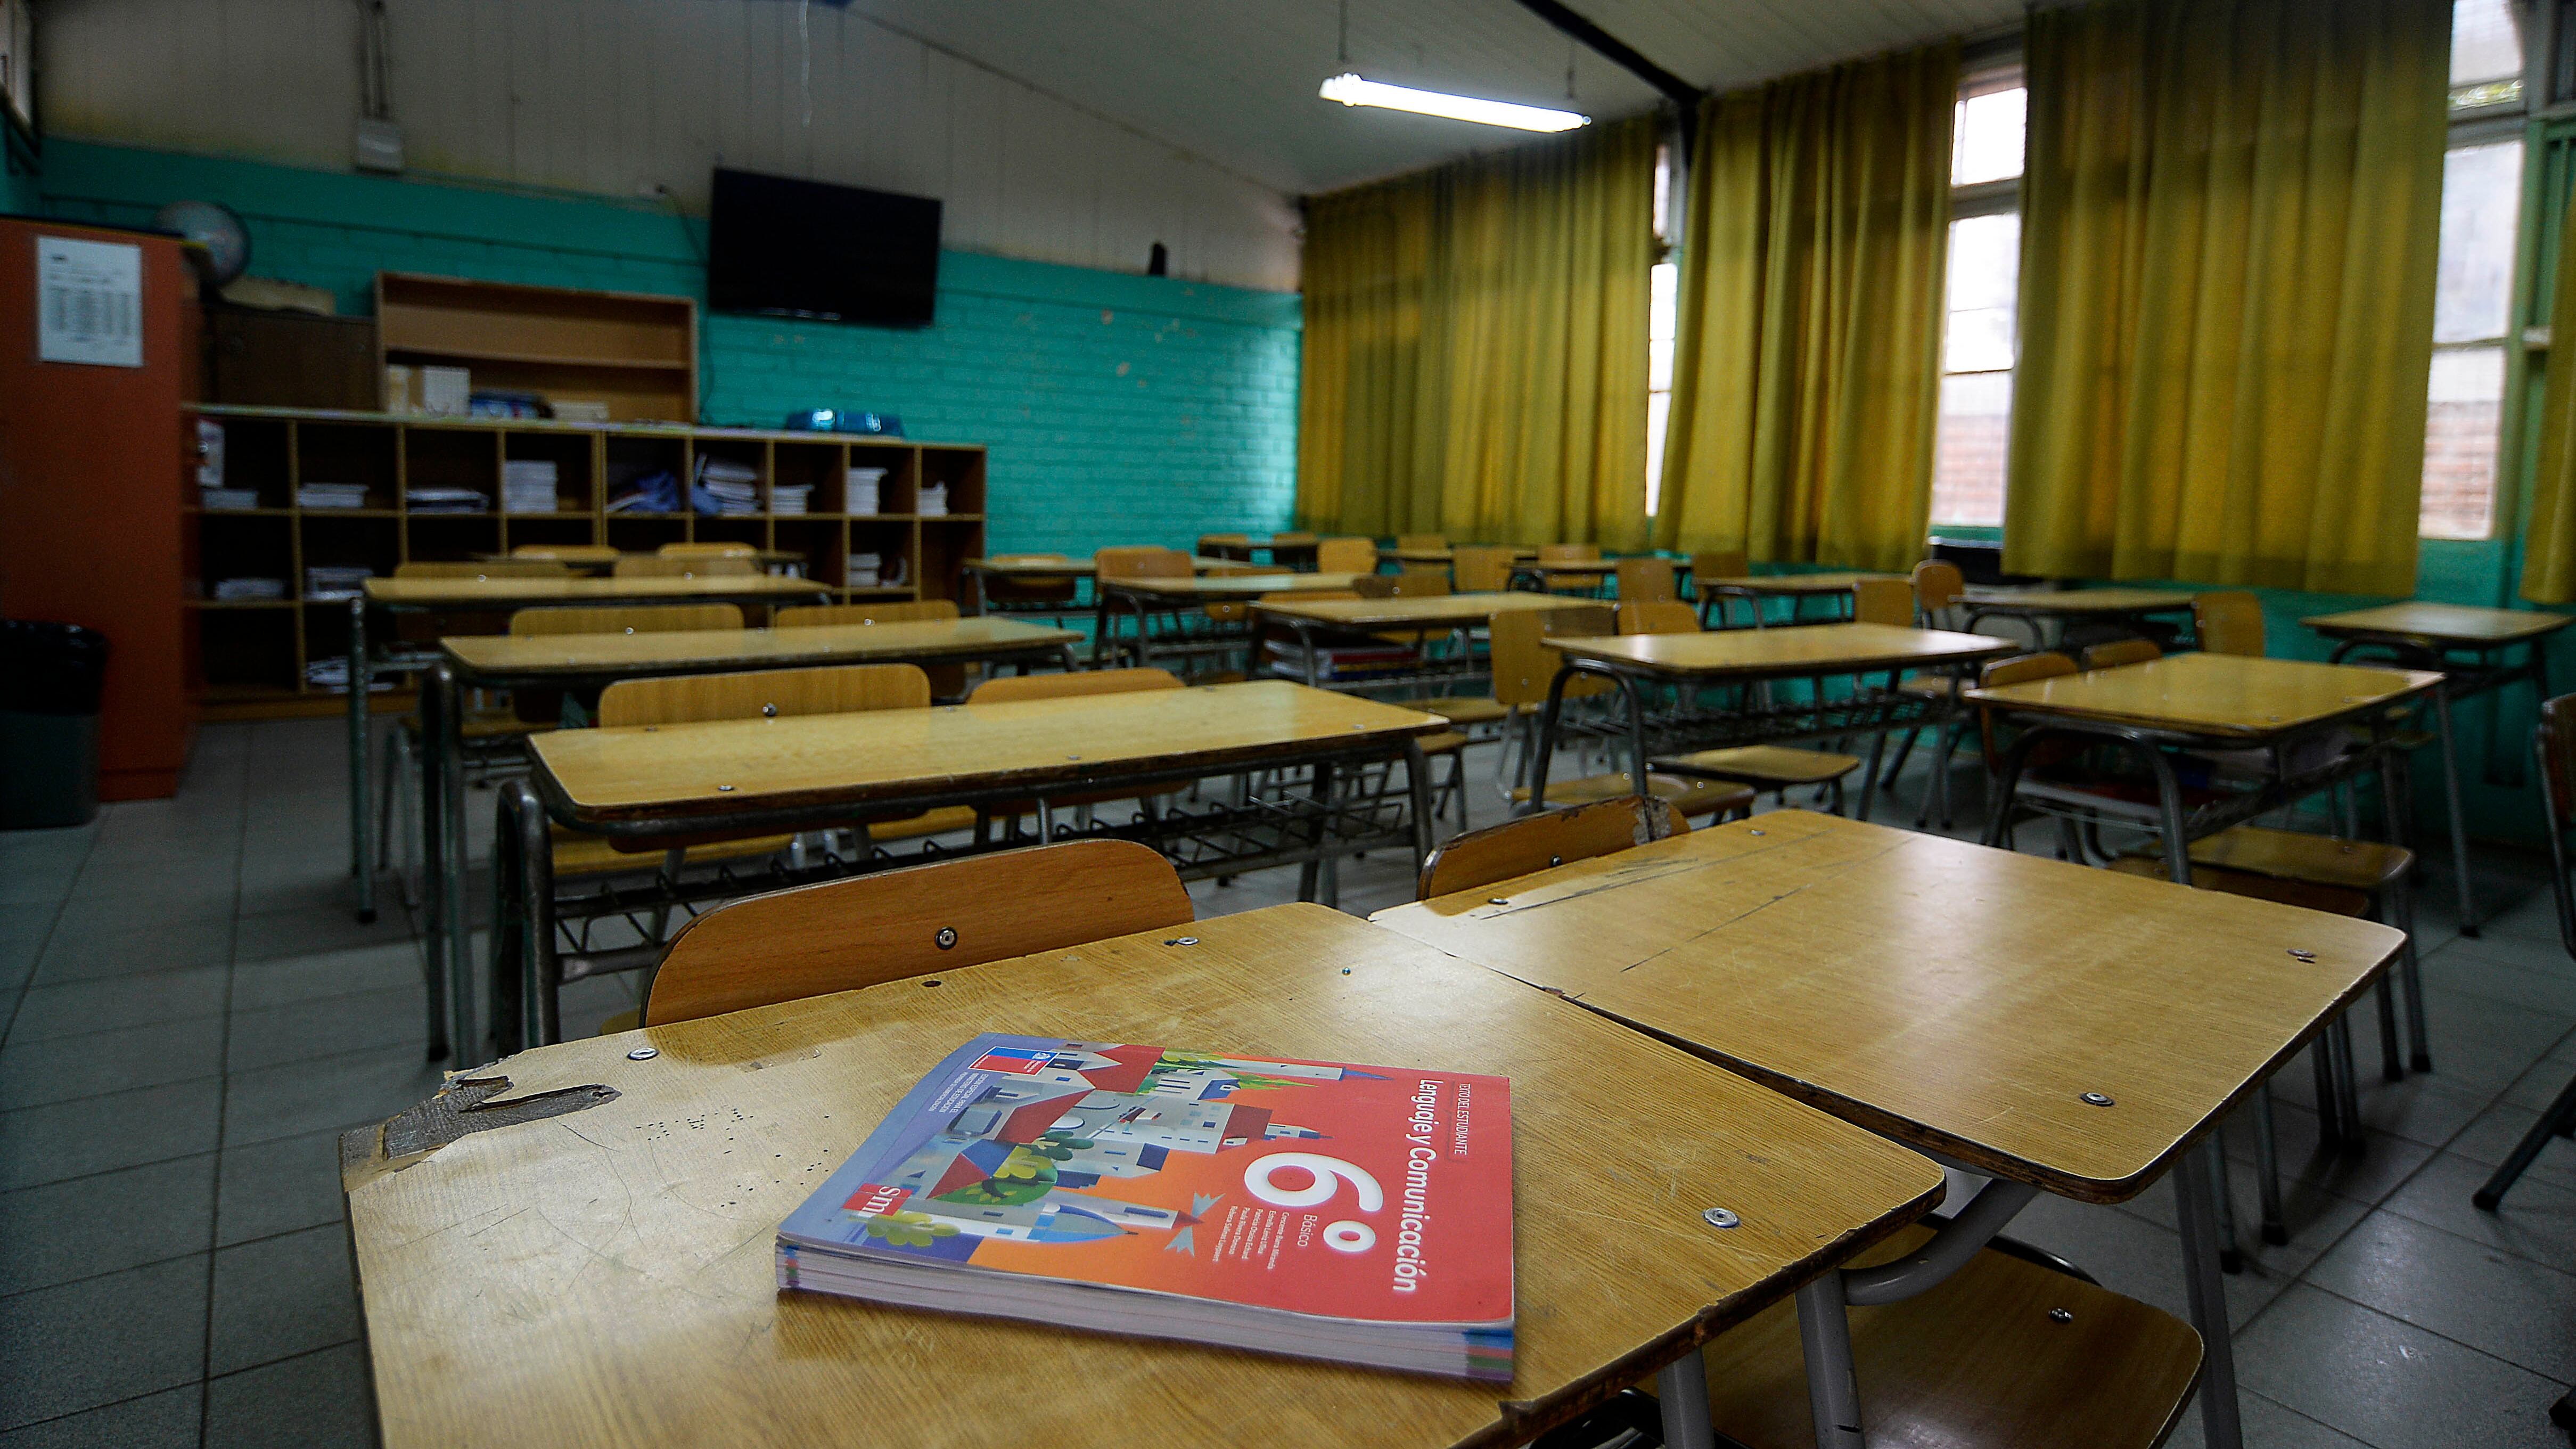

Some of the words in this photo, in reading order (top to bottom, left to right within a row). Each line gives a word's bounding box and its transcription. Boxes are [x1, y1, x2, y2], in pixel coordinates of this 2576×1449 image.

[1408, 1079, 1443, 1132] Lenguaje
[1457, 1083, 1471, 1098] TEXTO
[1457, 1098, 1470, 1110] DEL
[1405, 1133, 1431, 1145] y
[1454, 1110, 1470, 1155] ESTUDIANTE
[1297, 1214, 1318, 1247] Básico
[1393, 1147, 1437, 1292] Comunicación
